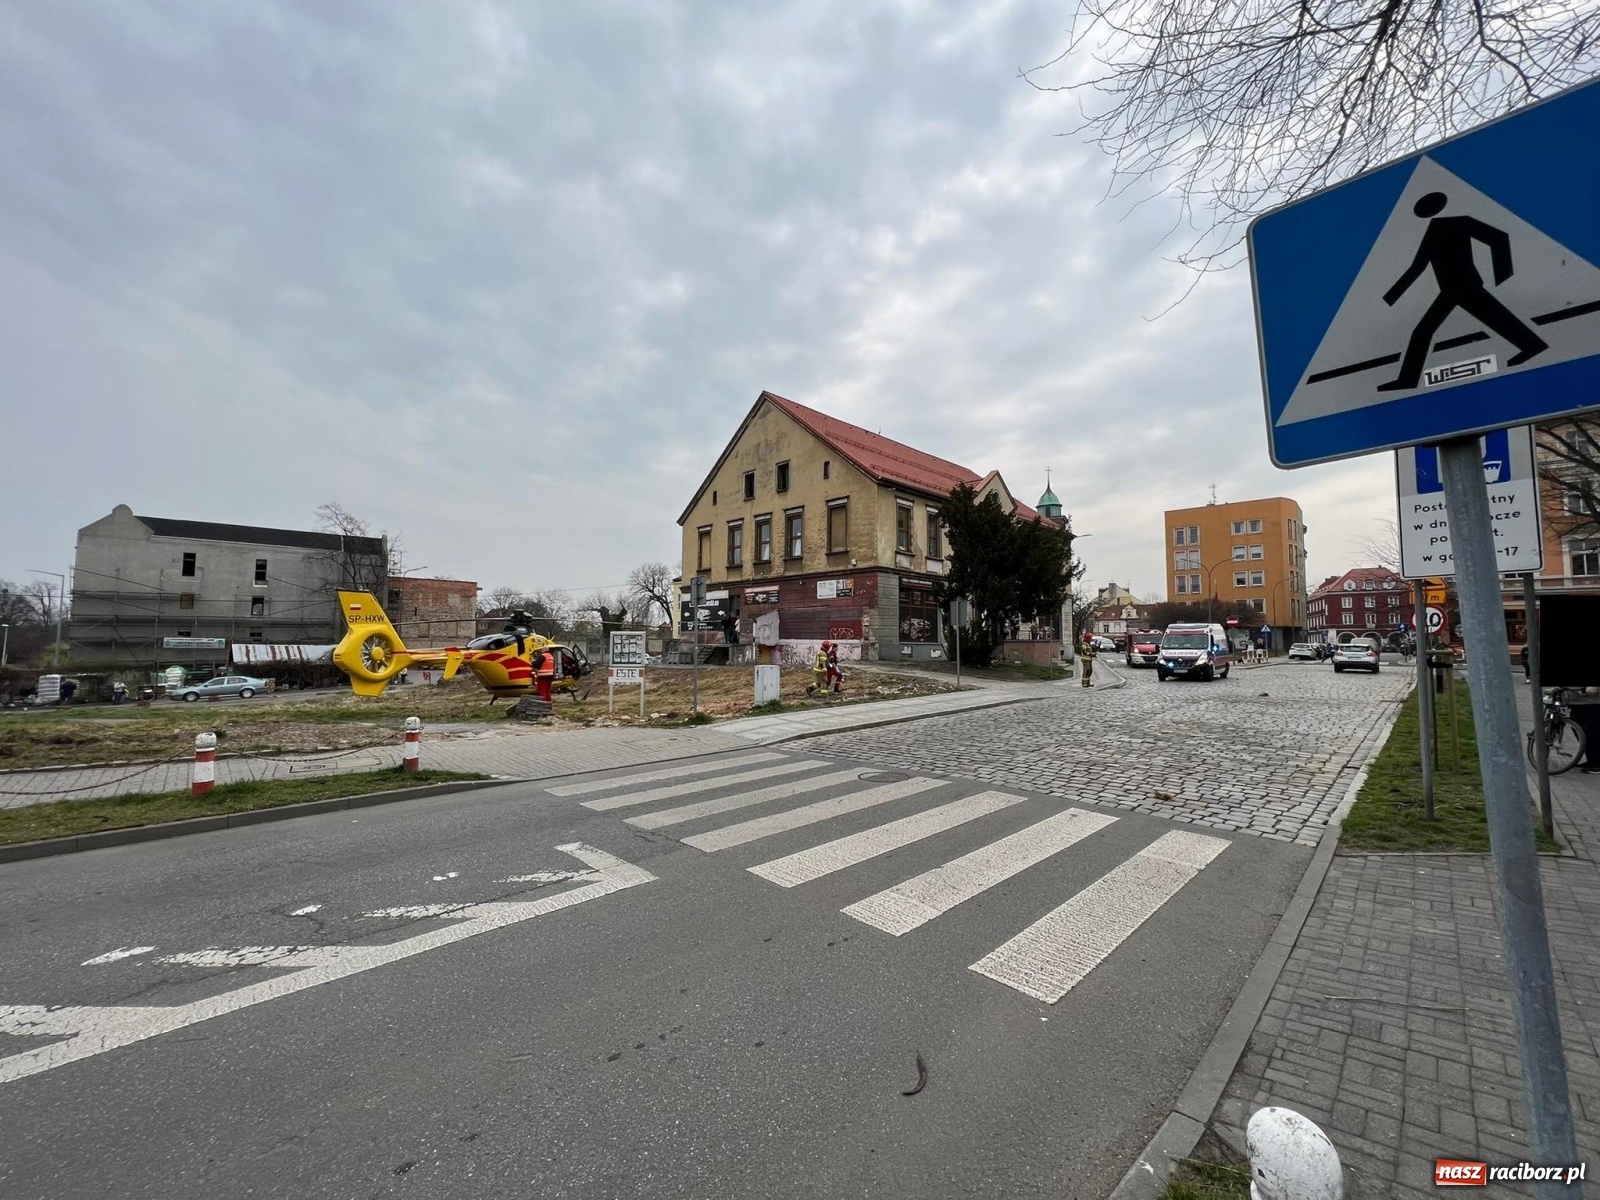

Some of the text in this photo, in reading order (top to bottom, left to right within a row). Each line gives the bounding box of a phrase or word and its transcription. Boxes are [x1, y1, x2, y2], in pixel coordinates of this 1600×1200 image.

[1414, 495, 1515, 513] Post tny
[1429, 519, 1448, 529] dn
[1430, 535, 1448, 546] po
[348, 614, 385, 623] SP-HXW
